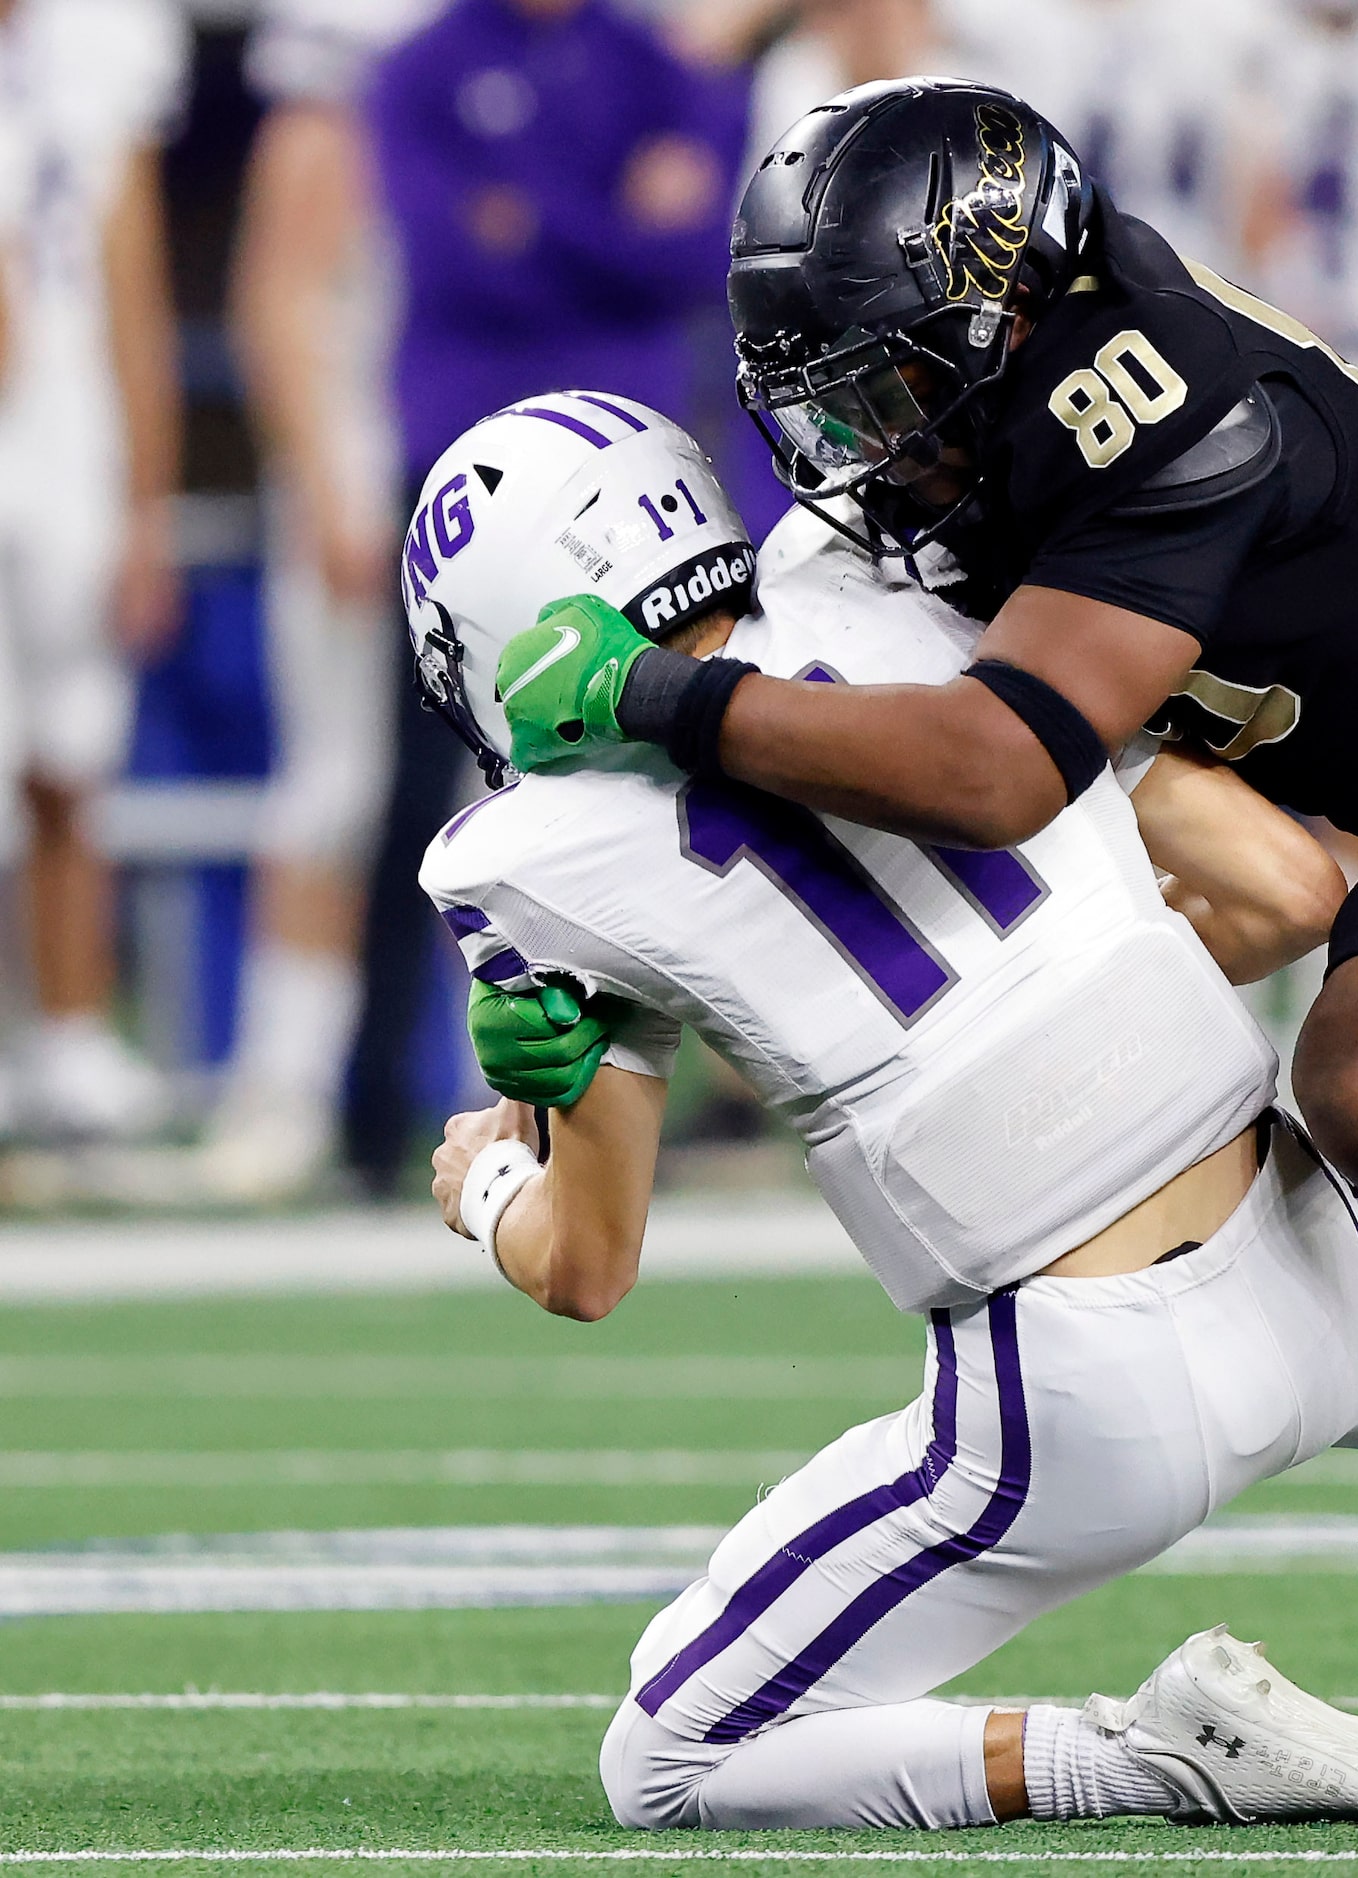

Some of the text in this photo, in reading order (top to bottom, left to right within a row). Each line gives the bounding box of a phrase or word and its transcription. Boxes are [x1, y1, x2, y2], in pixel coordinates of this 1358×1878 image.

[1047, 329, 1188, 468] 80
[403, 473, 475, 610] NG
[637, 478, 708, 542] 11
[590, 560, 613, 583] LARGE
[641, 548, 757, 629] Riddell
[676, 659, 1052, 1031] 1
